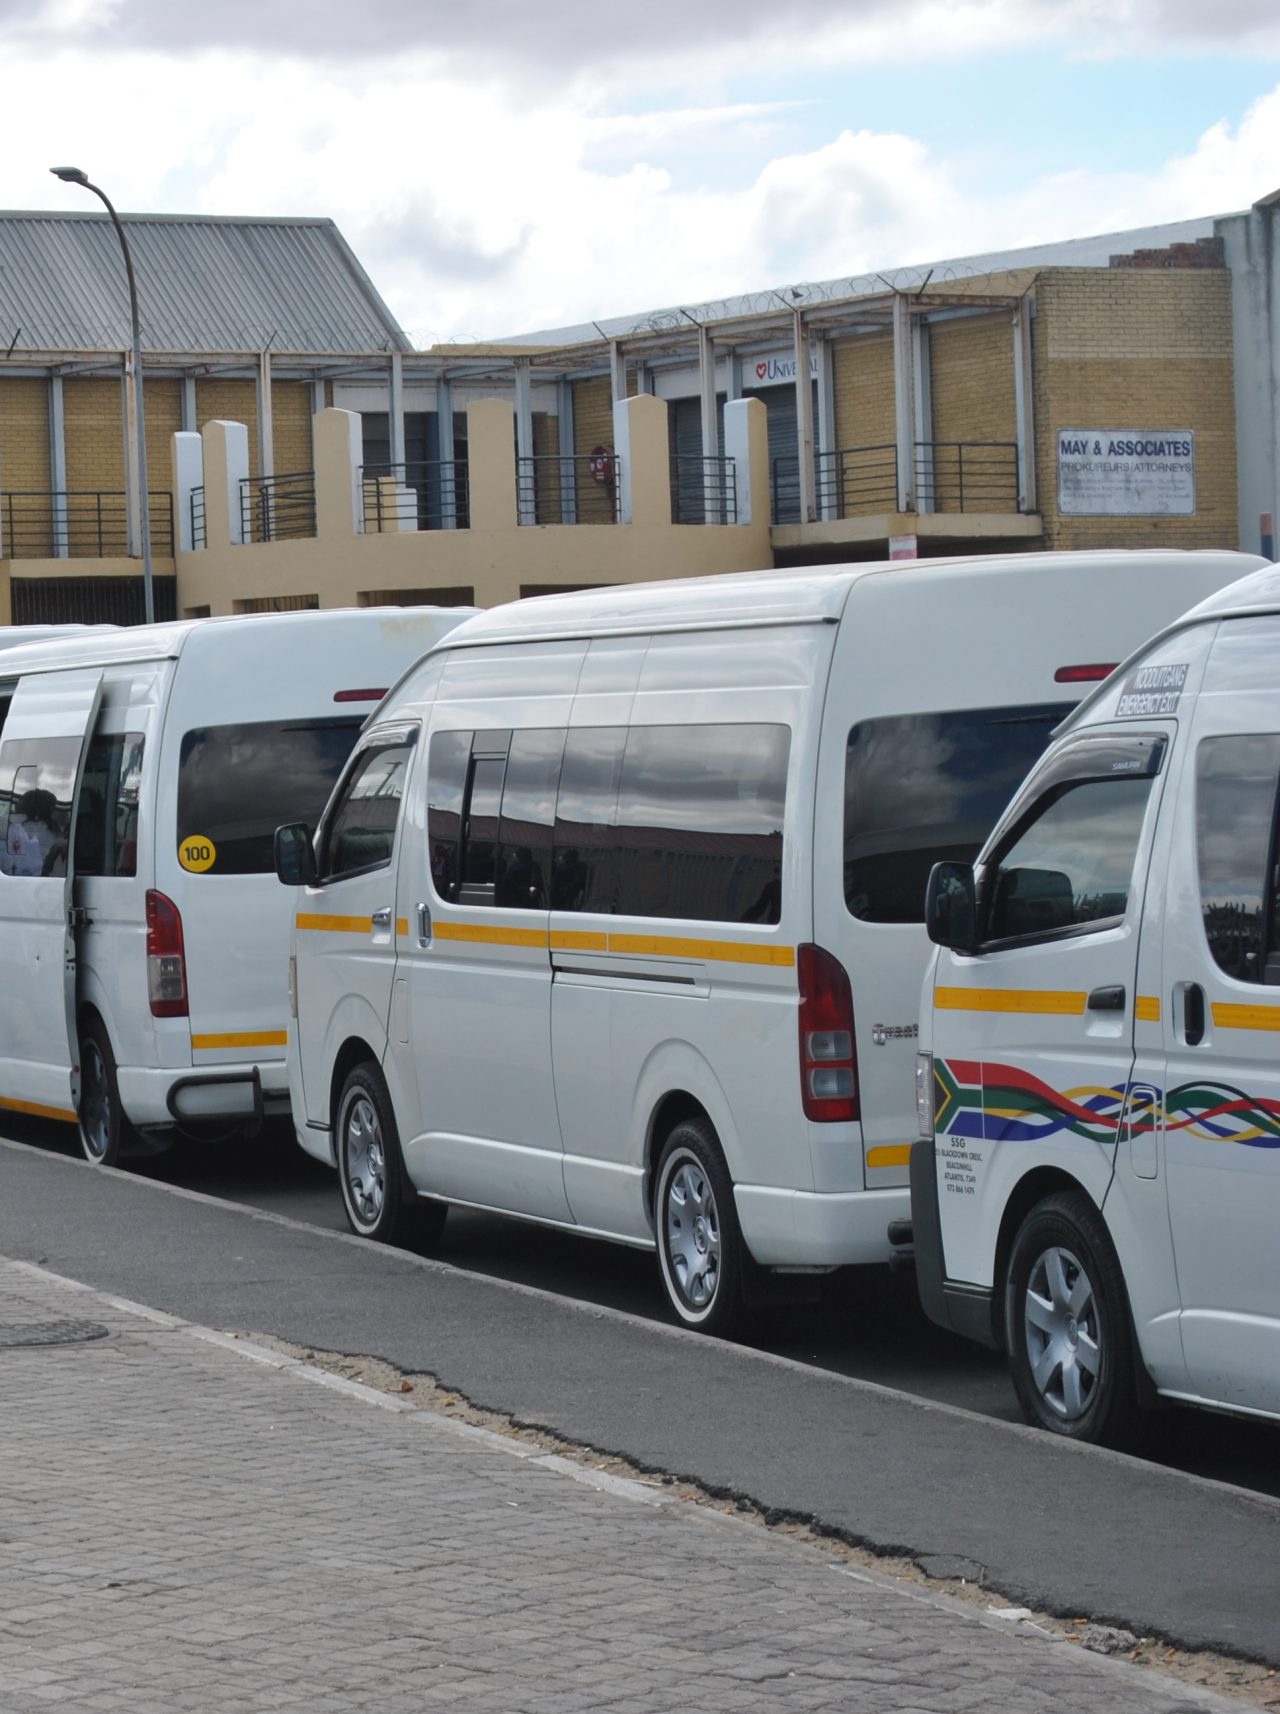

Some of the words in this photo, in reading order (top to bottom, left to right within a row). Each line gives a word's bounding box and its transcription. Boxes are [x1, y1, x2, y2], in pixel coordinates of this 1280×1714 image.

[1061, 440, 1088, 455] MAY
[1093, 440, 1102, 456] &
[1108, 440, 1190, 457] ASSOCIATES
[1134, 664, 1187, 689] NOODUITGANG
[1117, 692, 1163, 715] EMERGENCY
[1160, 691, 1181, 714] EXIT
[184, 845, 210, 861] 100
[951, 1137, 966, 1148] SSG
[941, 1149, 968, 1159] BLACKDOWN
[946, 1161, 972, 1171] BEACONHILL
